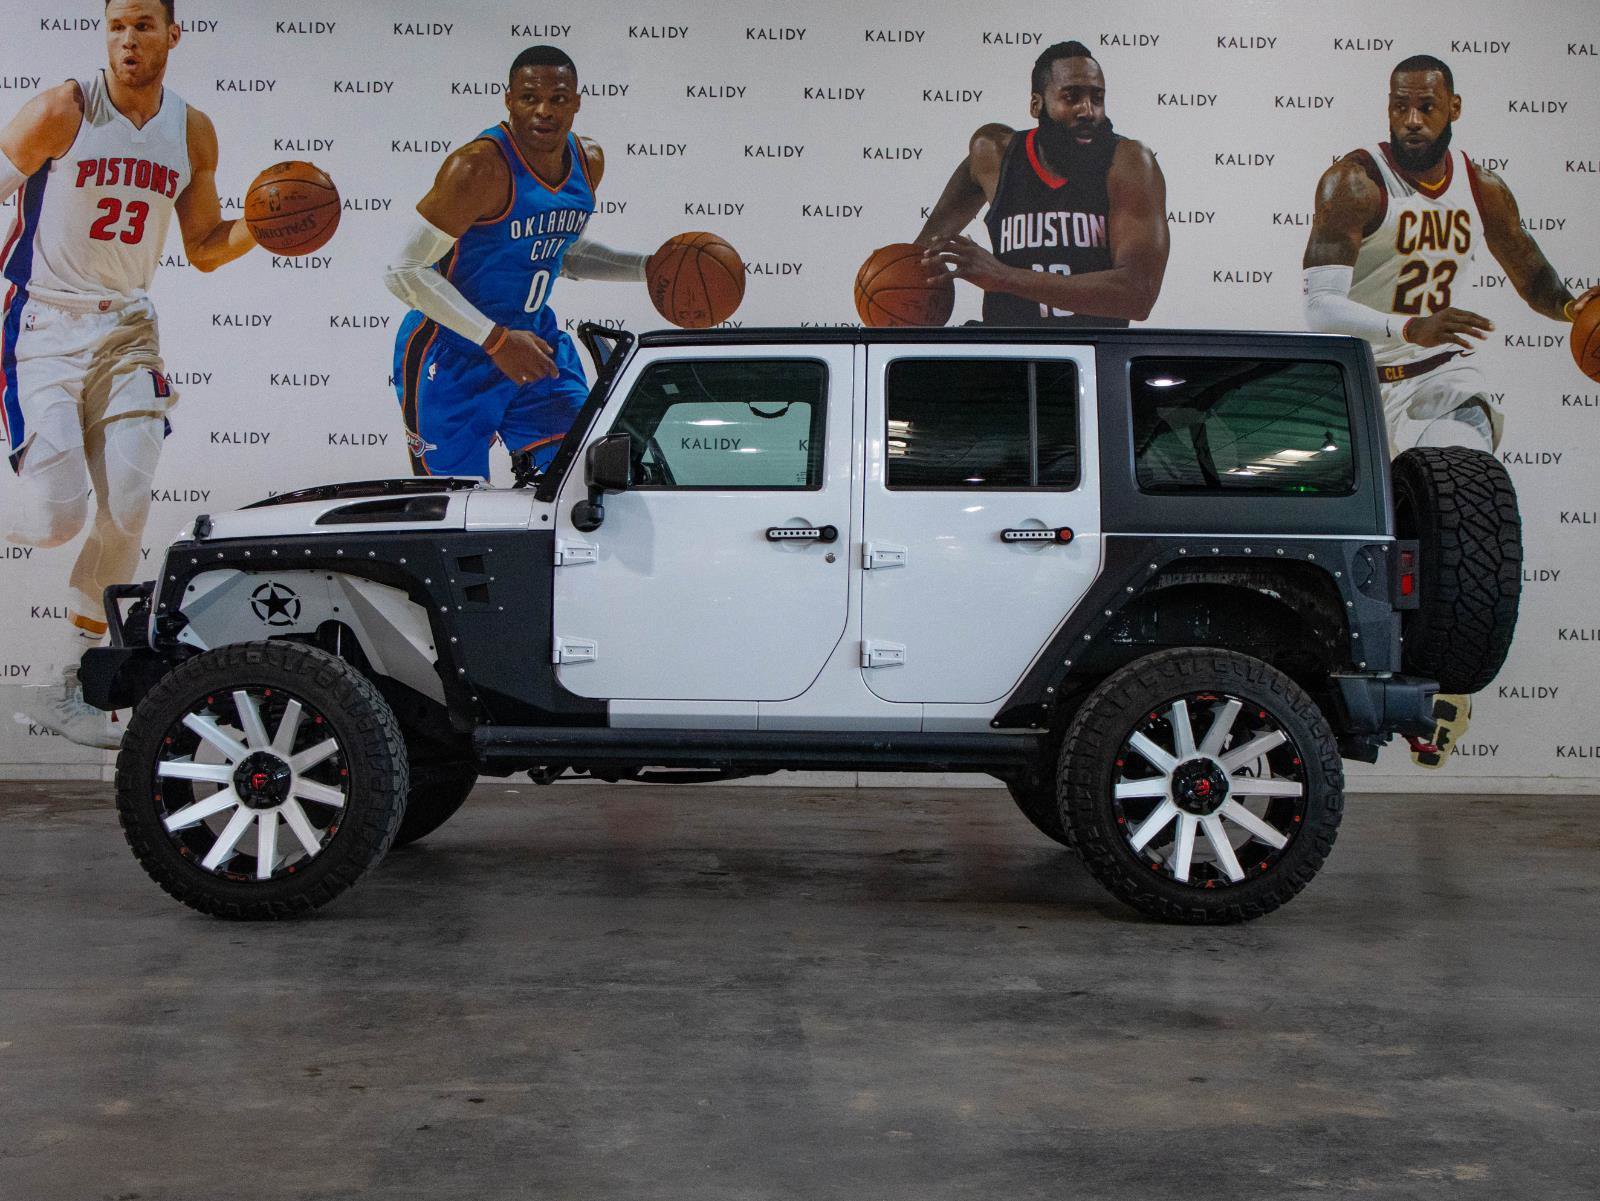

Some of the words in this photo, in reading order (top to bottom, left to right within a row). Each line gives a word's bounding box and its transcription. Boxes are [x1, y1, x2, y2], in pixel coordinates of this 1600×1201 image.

[41, 19, 100, 30] KALIDY
[182, 20, 218, 32] LIDY
[277, 22, 335, 33] KALIDY
[394, 24, 453, 35] KALIDY
[512, 25, 571, 37] KALIDY
[629, 26, 688, 38] KALIDY
[747, 28, 806, 40] KALIDY
[866, 30, 925, 42] KALIDY
[983, 33, 1042, 44] KALIDY
[1101, 34, 1159, 46] KALIDY
[1218, 37, 1277, 48] KALIDY
[1334, 38, 1393, 51] KALIDY
[1452, 41, 1510, 53] KALIDY
[1568, 44, 1598, 55] KAL
[0, 76, 41, 89] LIDY
[217, 80, 275, 91] KALIDY
[334, 81, 393, 93] KALIDY
[581, 84, 629, 96] ALIDY
[687, 86, 746, 98] KALIDY
[805, 88, 864, 100] KALIDY
[923, 90, 982, 102] KALIDY
[1158, 94, 1217, 106] KALIDY
[1276, 96, 1334, 108] KALIDY
[1509, 101, 1567, 113] KALIDY
[275, 139, 333, 151] KALIDY
[392, 141, 451, 153] KALIDY
[628, 144, 686, 155] KALIDY
[745, 145, 804, 157] KALIDY
[864, 147, 922, 159] KALIDY
[1216, 154, 1274, 166] KALIDY
[1472, 158, 1509, 170] IDY
[76, 158, 180, 199] PISTONS
[343, 198, 392, 210] ALIDY
[593, 202, 627, 214] IDY
[685, 203, 744, 215] KALIDY
[803, 205, 862, 217] KALIDY
[1167, 211, 1216, 223] ALIDY
[90, 198, 149, 245] 23
[510, 209, 588, 240] OKLAHOM
[1273, 212, 1310, 225] KALI
[1519, 217, 1566, 230] ALIDY
[1000, 211, 1105, 254] HOUSTON
[1397, 209, 1471, 256] CAVS
[530, 238, 566, 261] CITY
[273, 257, 332, 269] KALIDY
[744, 262, 803, 275] KALIDY
[1214, 271, 1272, 283] KALIDY
[1472, 276, 1507, 288] IDY
[1563, 277, 1600, 289] KALI
[524, 269, 550, 313] 0
[1392, 259, 1458, 315] 23
[213, 314, 271, 326] KALIDY
[330, 316, 389, 328] KALIDY
[1505, 335, 1564, 347] KALIDY
[166, 372, 212, 384] ALIDY
[1385, 366, 1406, 381] CLE
[271, 374, 330, 386] KALIDY
[1562, 394, 1600, 406] KALI
[211, 432, 270, 444] KALIDY
[329, 433, 387, 445] KALIDY
[682, 438, 741, 450] KALIDY
[1502, 452, 1562, 465] KALIDY
[151, 490, 210, 501] KALIDY
[1561, 512, 1596, 523] KALI
[0, 547, 32, 559] IDY
[1523, 569, 1561, 581] LIDY
[32, 607, 67, 618] KALI
[1559, 629, 1600, 641] KALI
[0, 665, 31, 676] IDY
[1499, 686, 1558, 698] KALIDY
[1451, 744, 1499, 757] ALIDY
